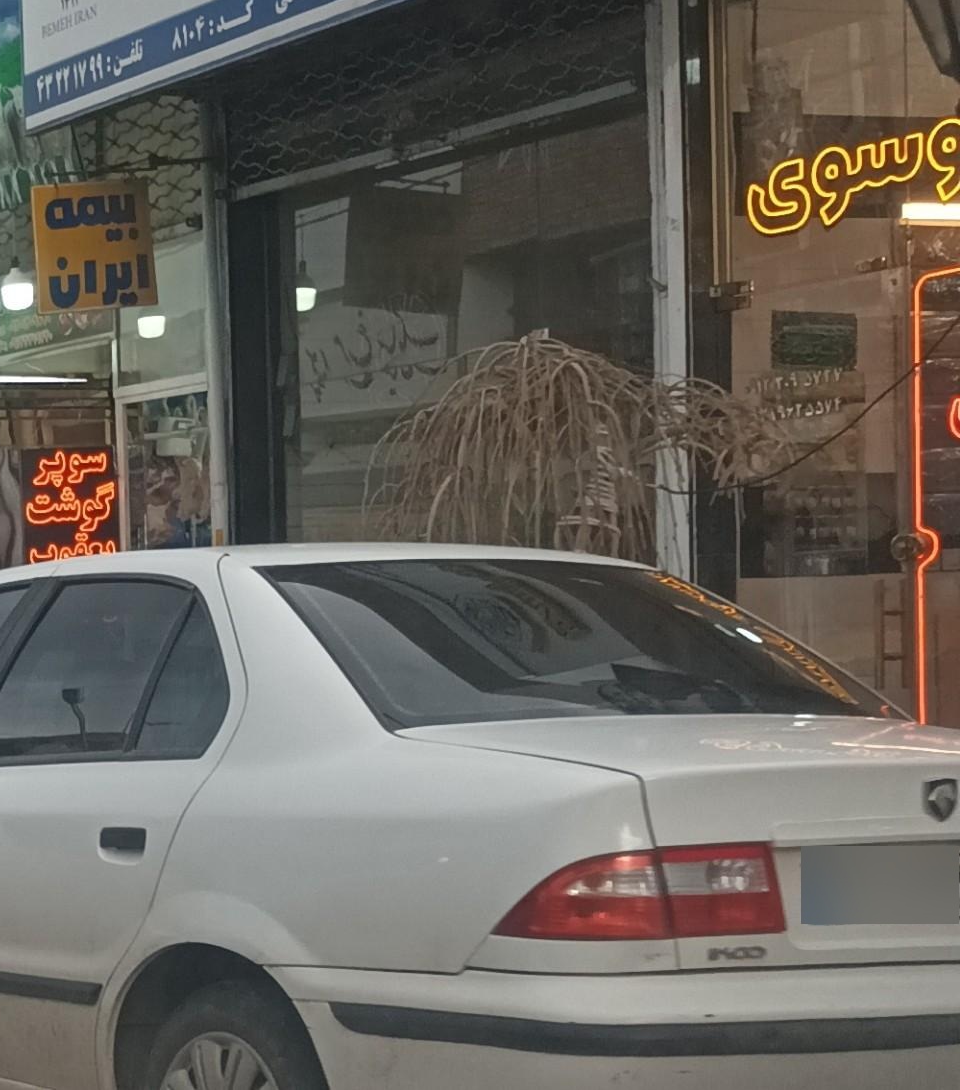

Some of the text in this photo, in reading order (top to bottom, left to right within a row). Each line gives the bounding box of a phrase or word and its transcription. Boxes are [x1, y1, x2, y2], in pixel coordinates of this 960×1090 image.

[171, 15, 206, 52] ۸۱۰۴
[746, 117, 960, 236] وسوی
[44, 192, 138, 244] بیمه
[47, 252, 151, 310] ایران
[32, 450, 108, 488] سوپر
[25, 481, 116, 532] گوشت
